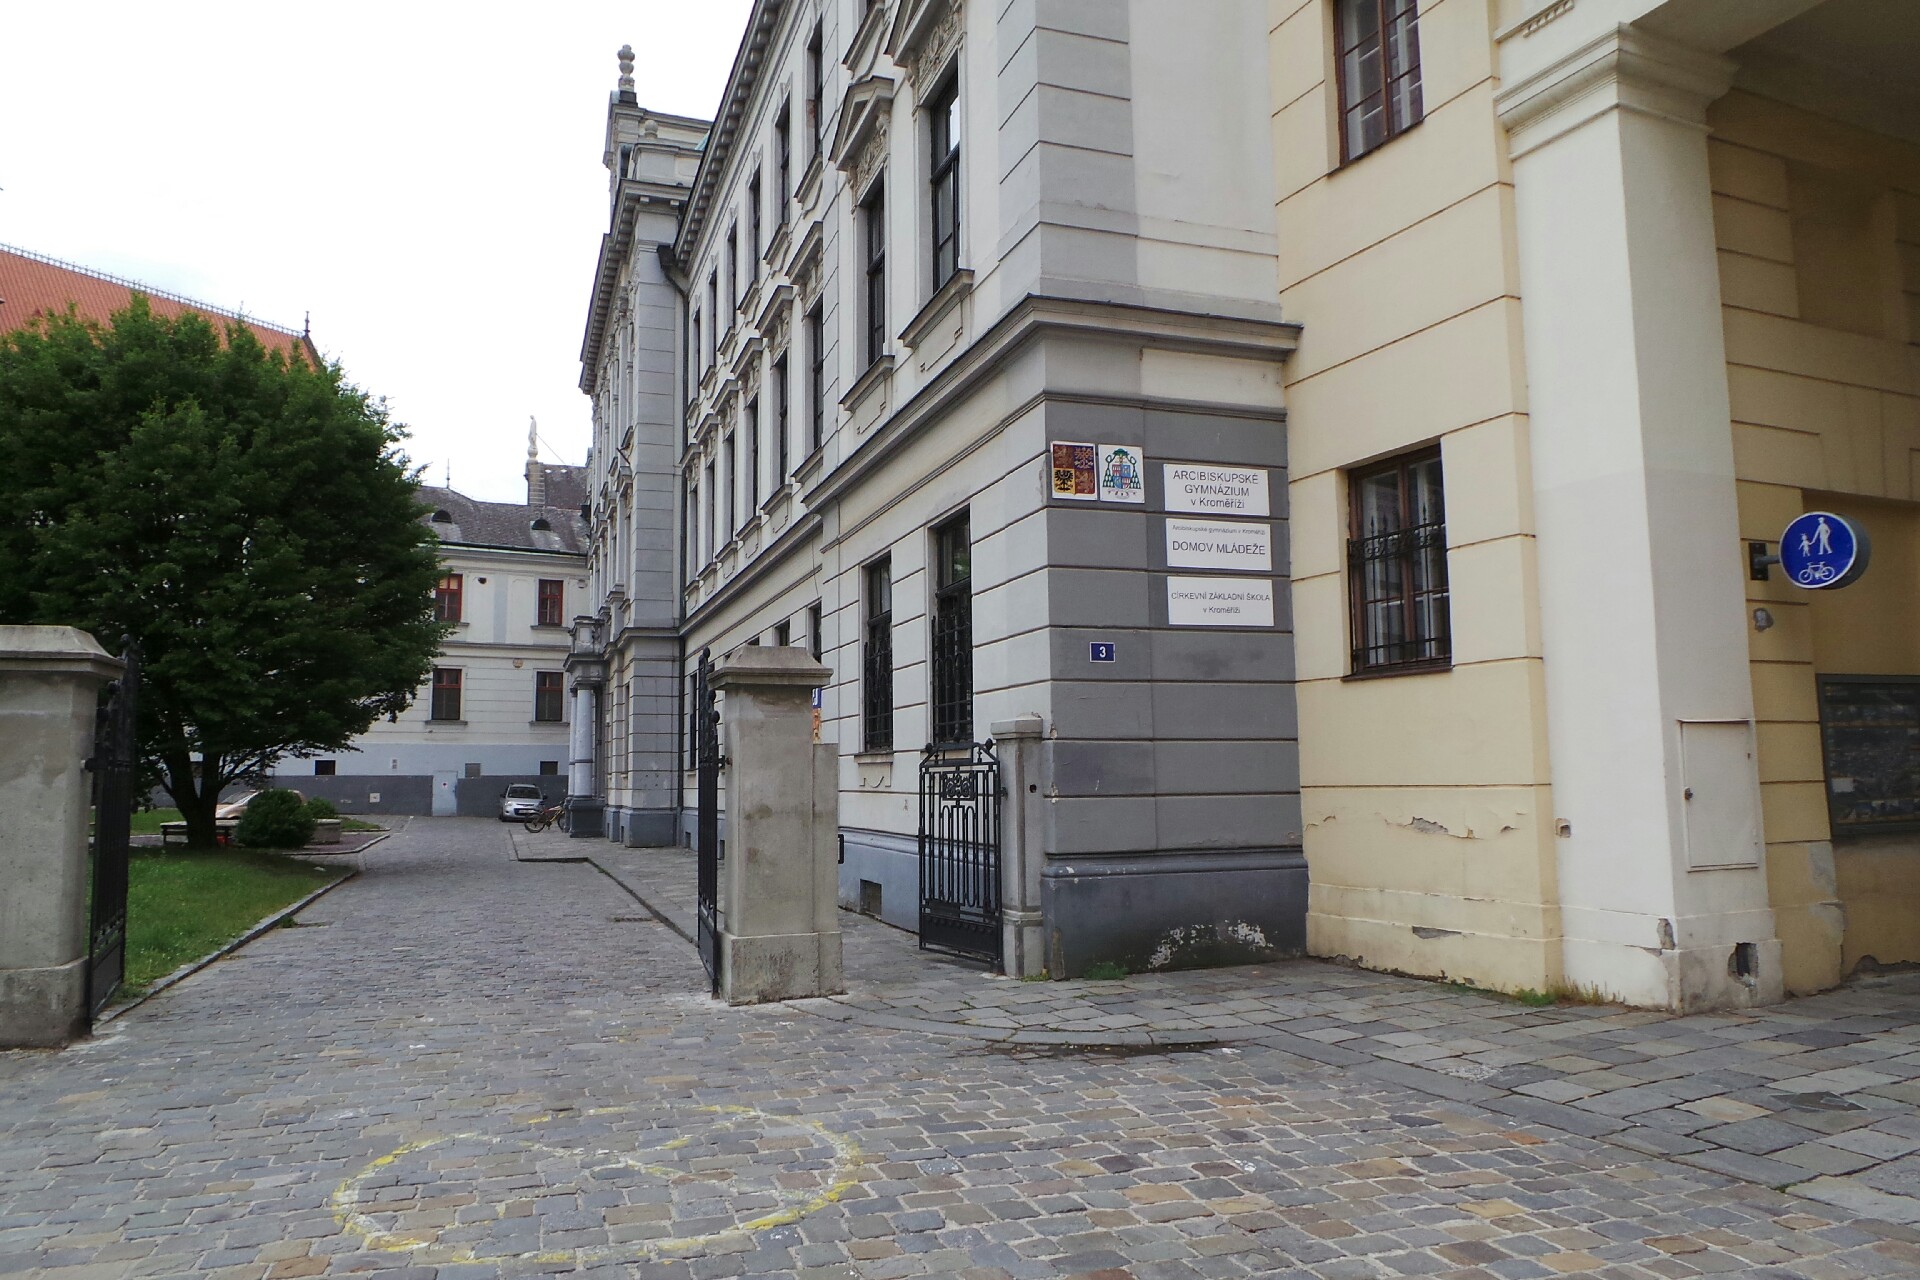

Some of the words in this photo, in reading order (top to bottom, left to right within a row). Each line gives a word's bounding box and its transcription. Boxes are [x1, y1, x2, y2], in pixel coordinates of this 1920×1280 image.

[1173, 470, 1258, 484] ARCIBISKUPSKÉ
[1184, 484, 1249, 496] GYMNÁZIUM
[1200, 497, 1244, 508] Kroměříži
[1172, 541, 1213, 552] DOMOV
[1216, 542, 1265, 555] MLÁDEŽE
[1171, 591, 1207, 600] CÍRKEVNÍ
[1209, 592, 1244, 601] ZÁKLADNÍ
[1246, 592, 1270, 601] ŠKOLA
[1099, 646, 1106, 658] 3
